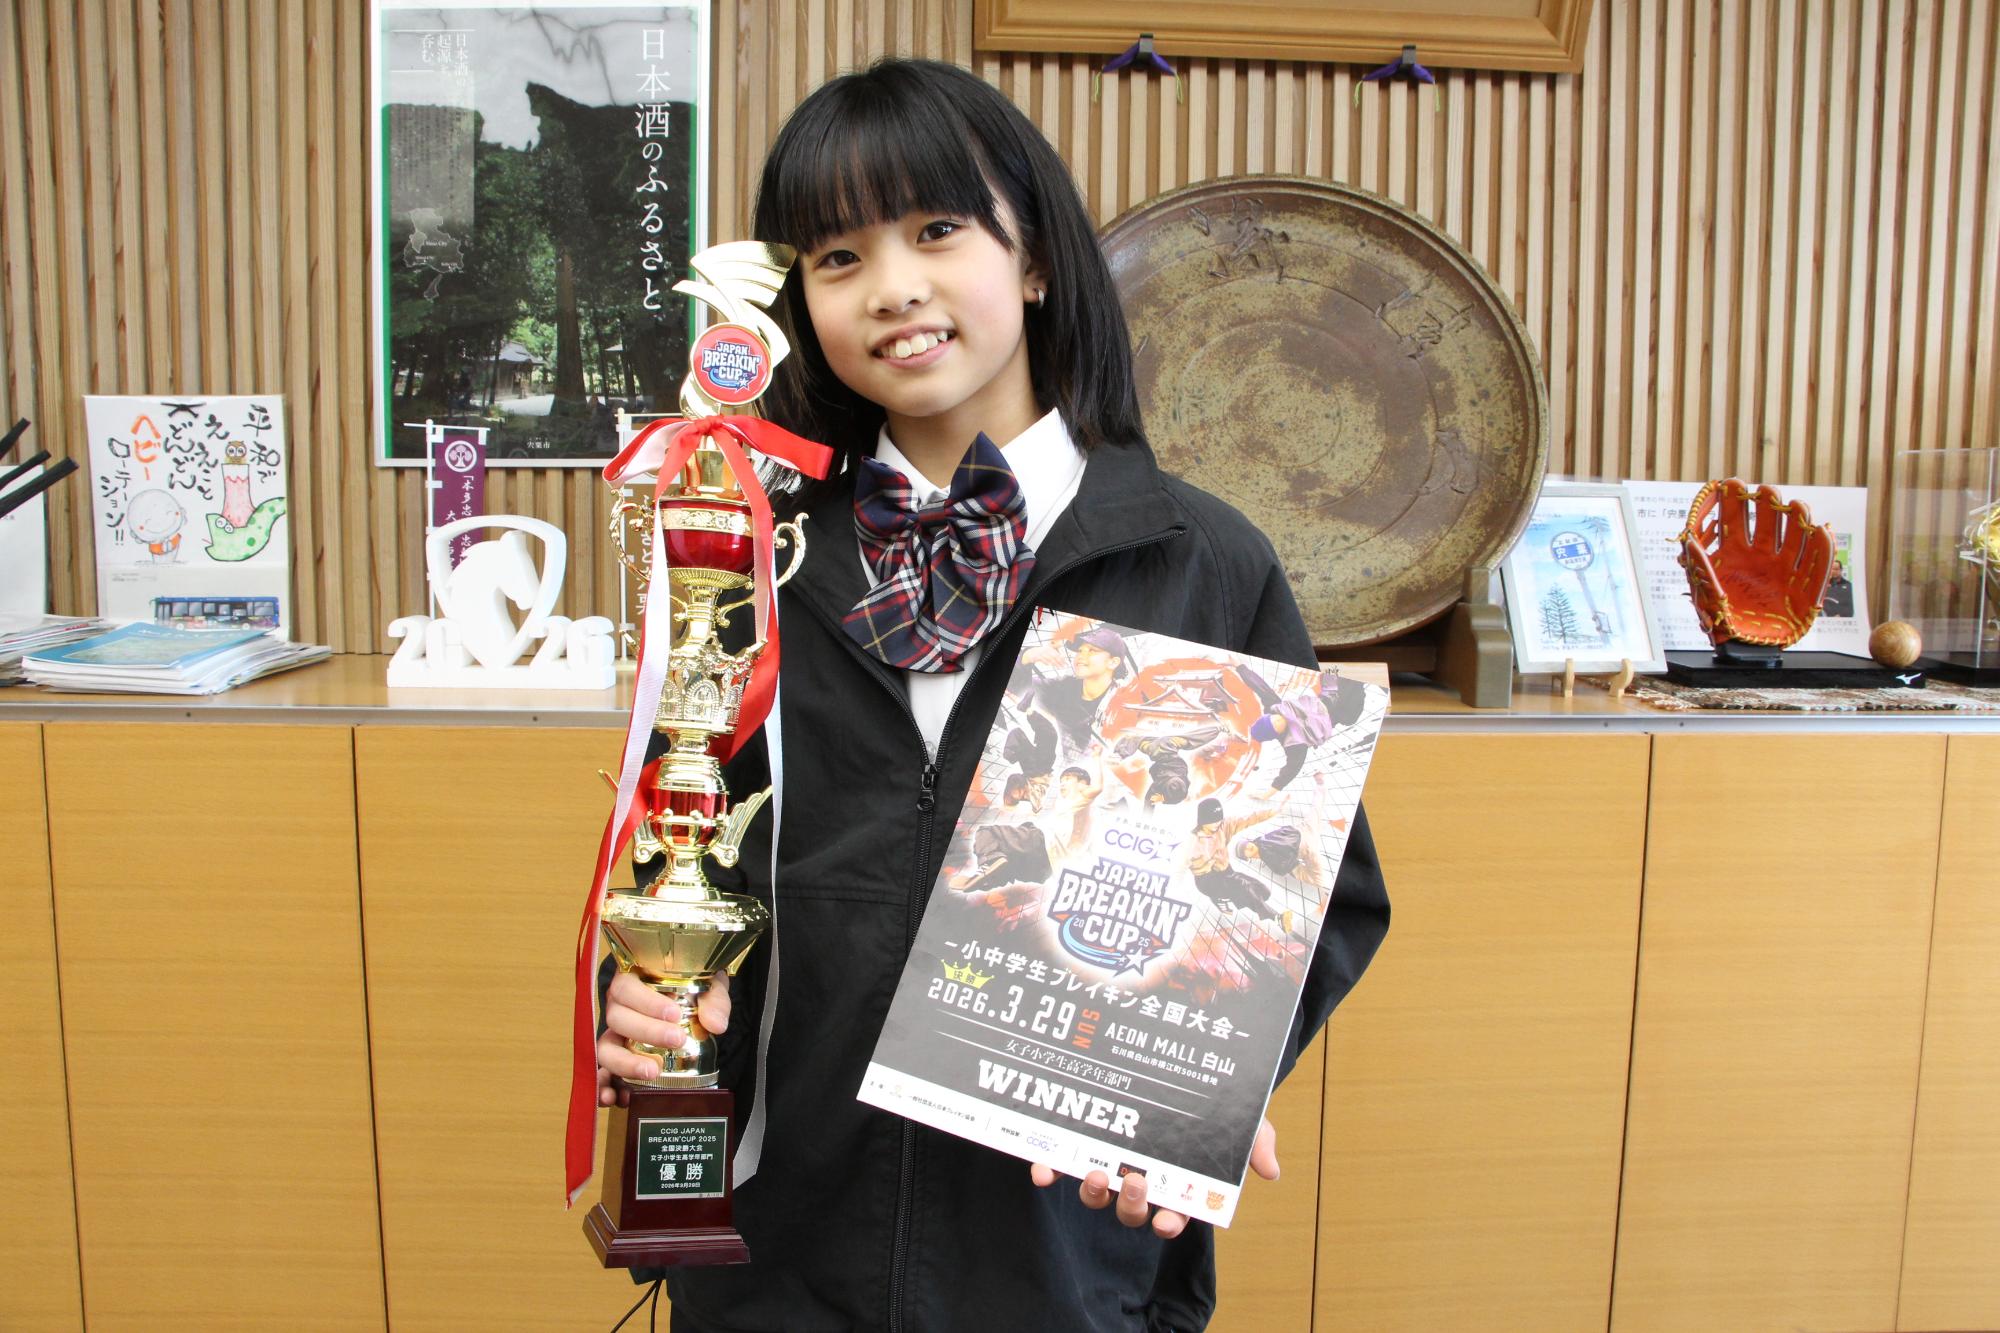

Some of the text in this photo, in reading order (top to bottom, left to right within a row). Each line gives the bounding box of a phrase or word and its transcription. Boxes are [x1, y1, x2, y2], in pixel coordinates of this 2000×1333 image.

[634, 28, 673, 310] 日本酒のふるさと
[703, 350, 761, 375] BREAKIN'
[716, 342, 749, 356] JAPAN
[718, 367, 743, 381] CUP
[131, 415, 162, 482] ヘビー
[163, 421, 197, 490] どんどん
[195, 413, 230, 501] ええこと
[242, 403, 281, 484] 平和で
[1104, 829, 1154, 855] CCIG
[1094, 859, 1167, 897] JAPAN
[1052, 872, 1188, 945] BREAKIN'
[1072, 917, 1085, 929] 20
[1082, 914, 1140, 951] CUP
[1137, 936, 1150, 948] 25
[927, 977, 1077, 1041] 2026.3.29
[1071, 1008, 1101, 1049] SUN
[1005, 1039, 1133, 1090] 女子小学生高学年部門
[1104, 1022, 1236, 1076] AEON MALL 白山
[978, 1059, 1141, 1139] WINNER
[650, 1153, 714, 1161] 女子小学生高学年部門
[661, 1144, 703, 1152] 全国決勝大会
[659, 1163, 704, 1181] 優勝
